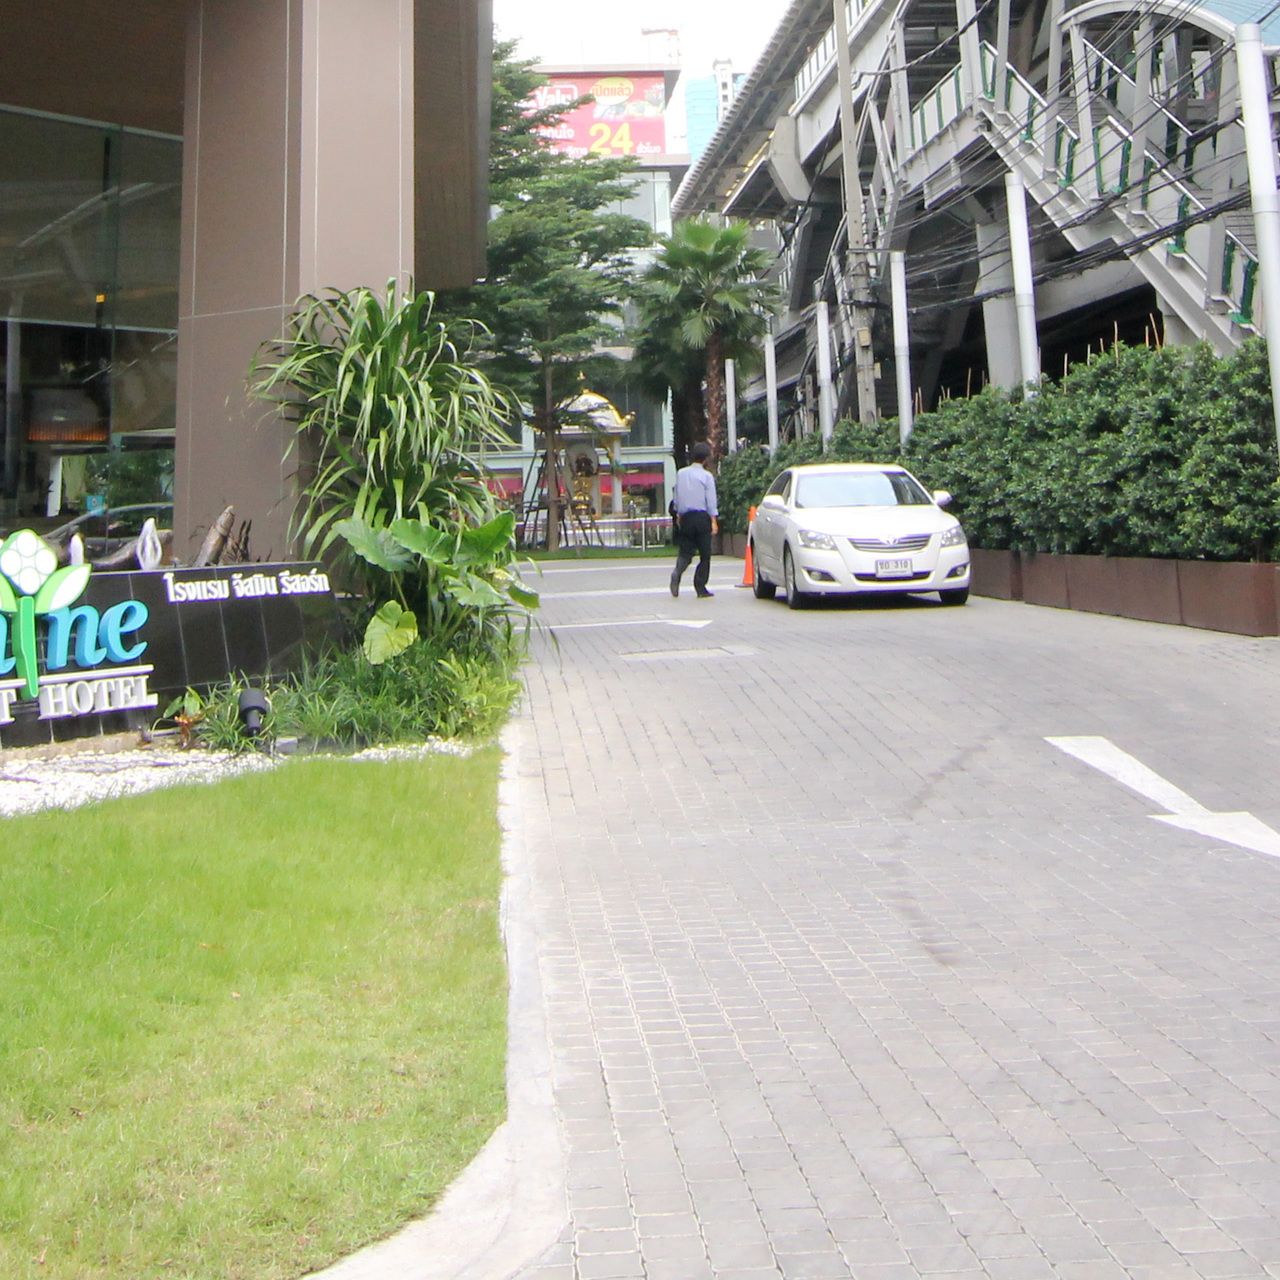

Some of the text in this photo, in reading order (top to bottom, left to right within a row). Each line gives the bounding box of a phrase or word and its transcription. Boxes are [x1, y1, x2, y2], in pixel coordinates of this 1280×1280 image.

[588, 122, 635, 155] 24
[162, 572, 230, 603] โรงแรม
[230, 572, 279, 599] จัสมิน
[37, 675, 160, 721] HOTEL
